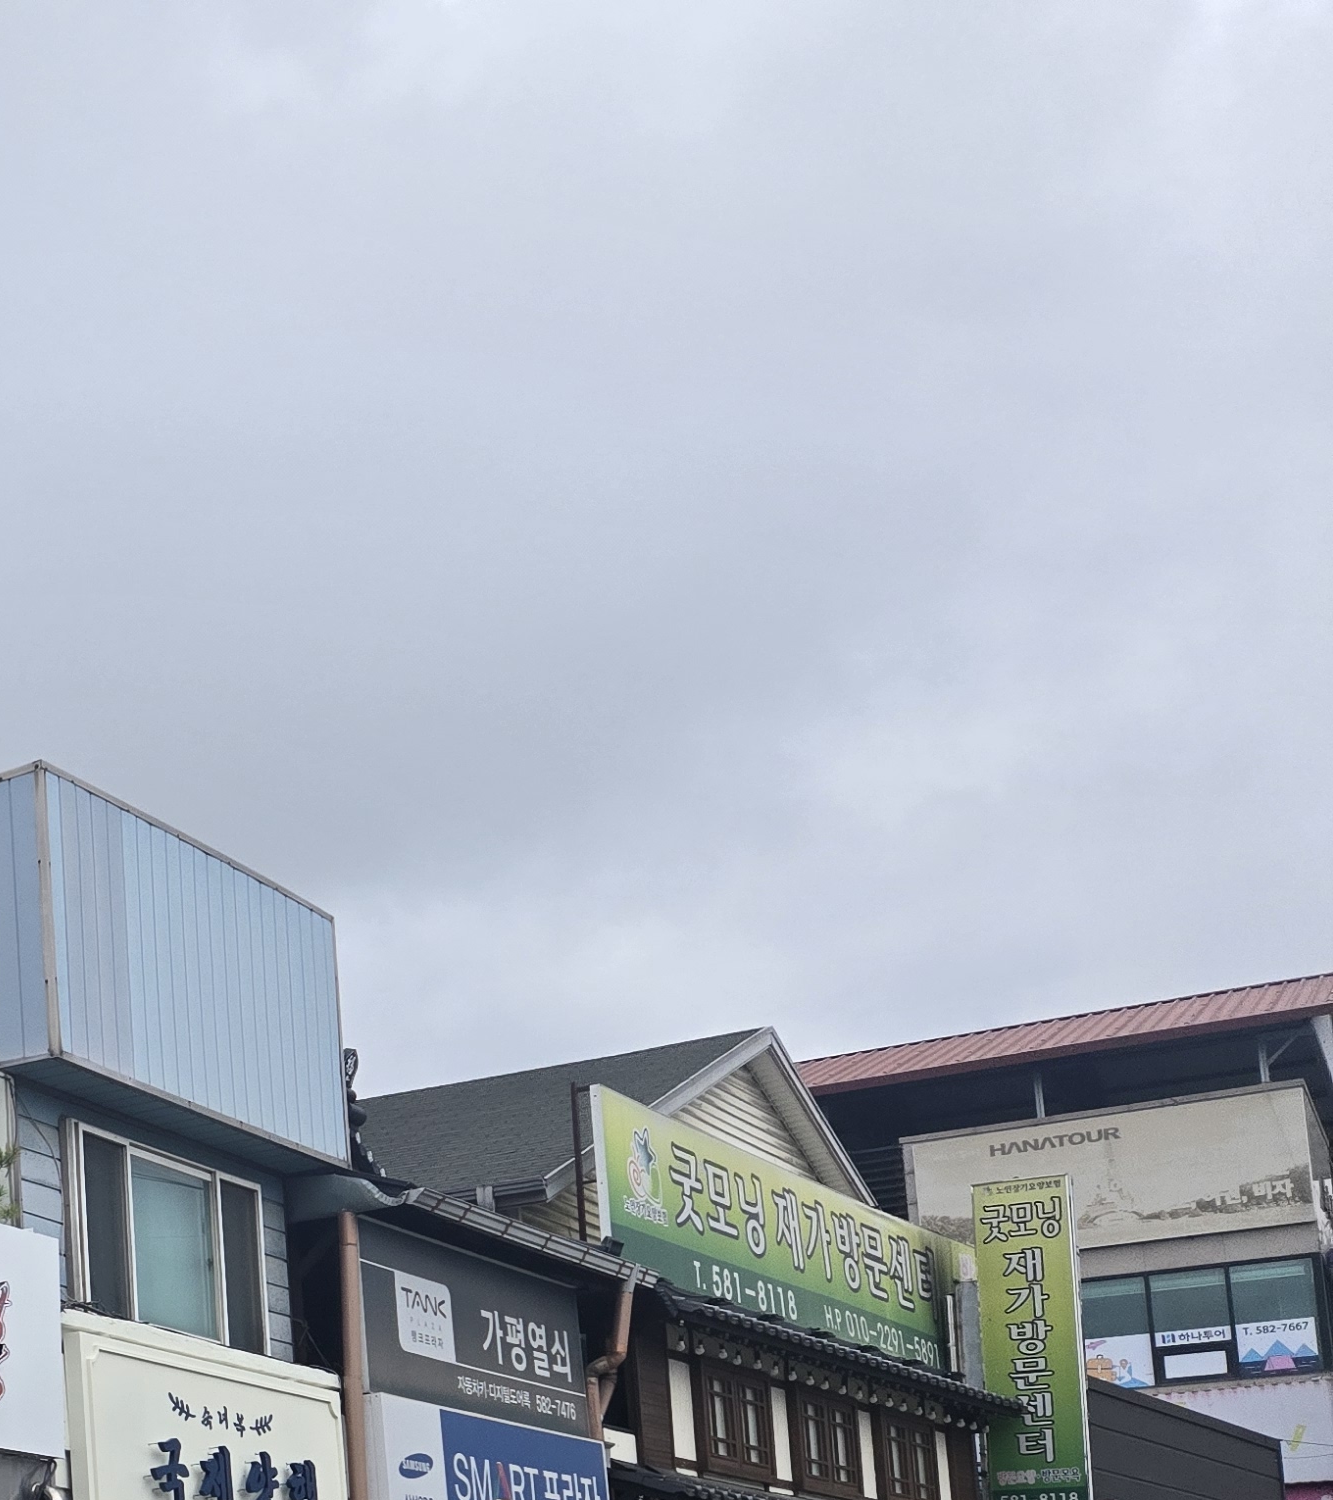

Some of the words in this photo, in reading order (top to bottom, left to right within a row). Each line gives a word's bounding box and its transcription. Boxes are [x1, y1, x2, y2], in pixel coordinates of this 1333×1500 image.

[989, 1126, 1121, 1158] HANATOUR
[668, 1141, 767, 1256] 굿모닝
[771, 1186, 935, 1312] 재가방문센터
[980, 1196, 1062, 1244] 굿모닝
[400, 1286, 447, 1319] TANK
[712, 1264, 798, 1321] 581-8118
[845, 1313, 940, 1366] 010-2291-5891
[1177, 1328, 1226, 1342] 하나투어
[1255, 1321, 1309, 1334] 582-7667
[480, 1309, 572, 1382] 가평열쇠
[1004, 1247, 1056, 1463] 재가방문센터
[535, 1394, 577, 1421] 582-7476
[401, 1459, 432, 1472] SAMSUNG
